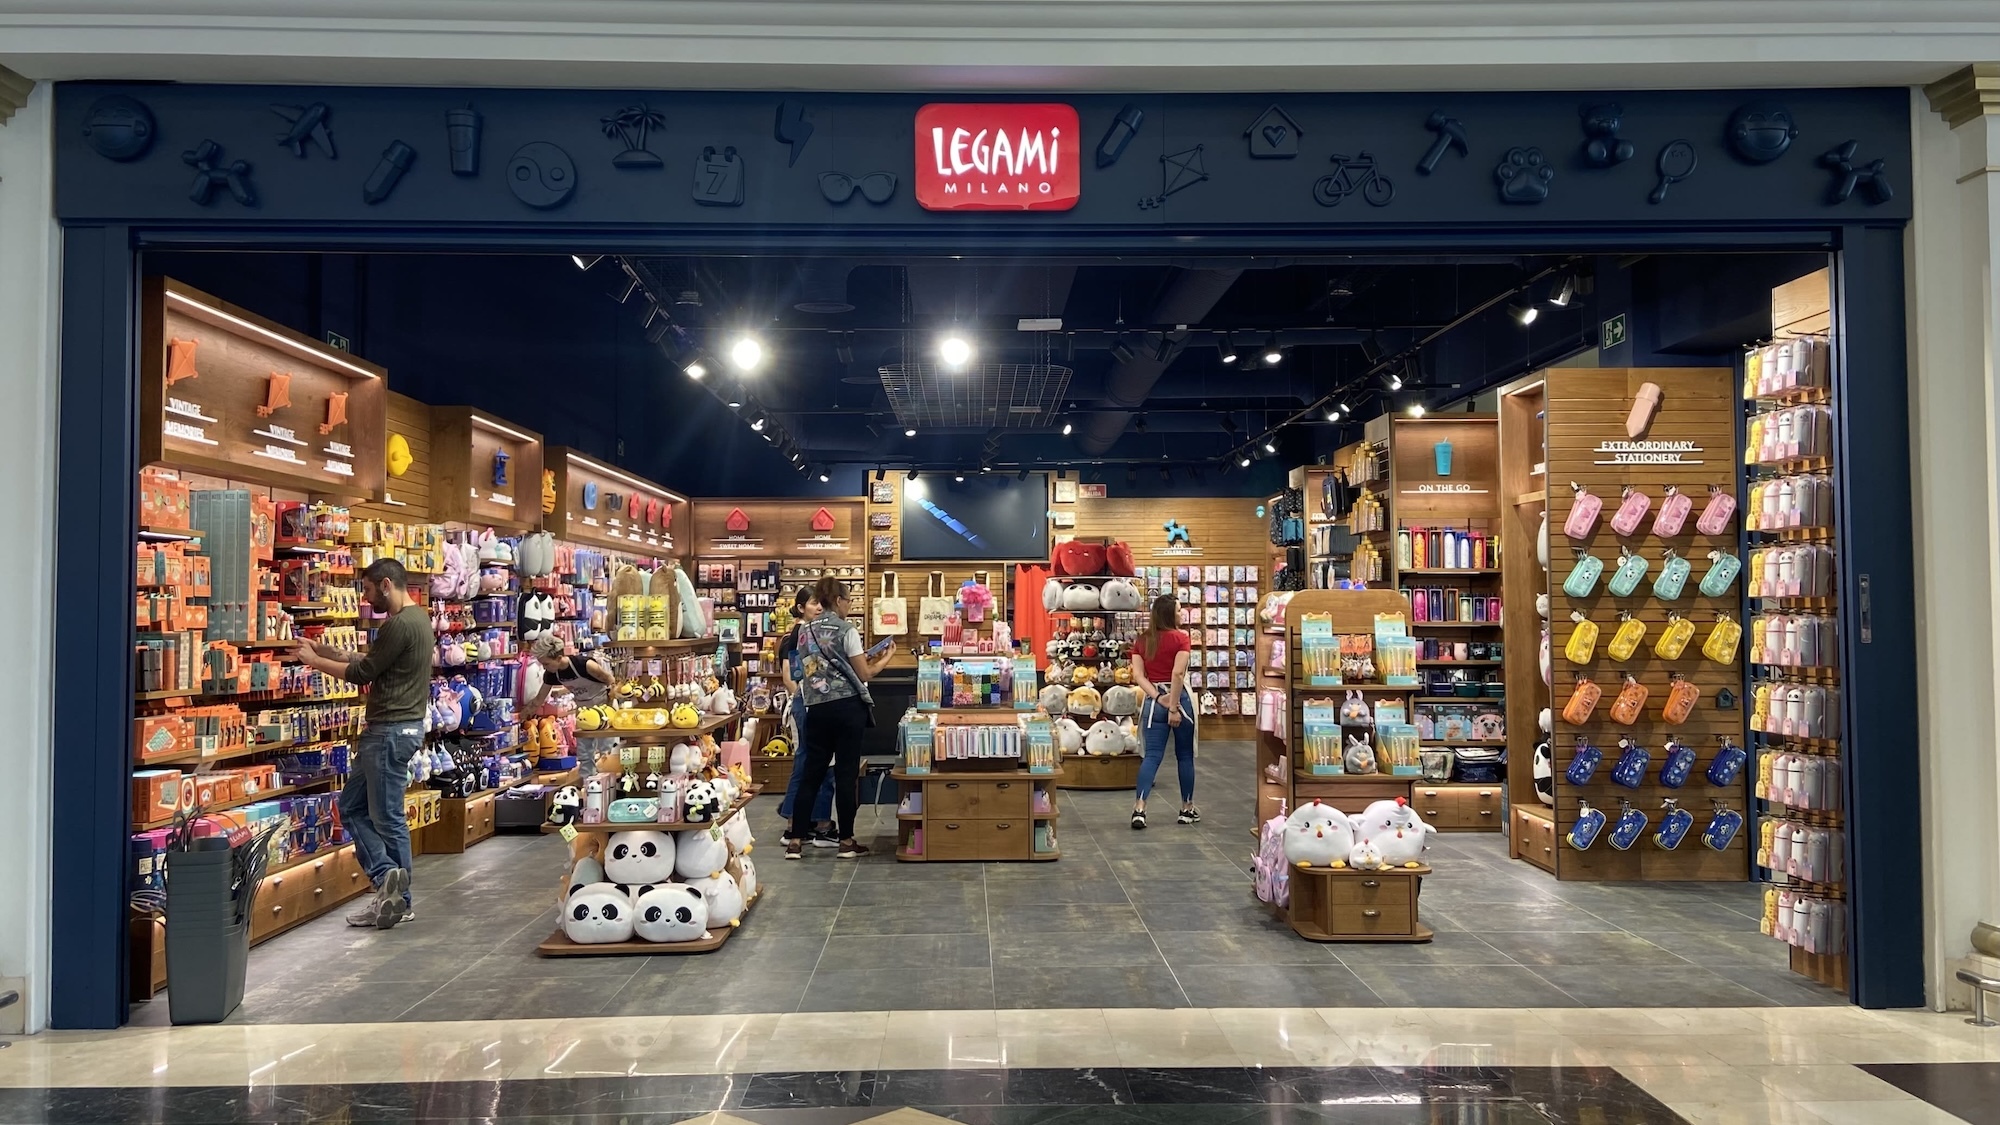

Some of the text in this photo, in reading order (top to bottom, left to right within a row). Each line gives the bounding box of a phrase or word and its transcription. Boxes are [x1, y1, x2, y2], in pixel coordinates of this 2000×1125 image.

[944, 182, 1051, 194] MILANO
[168, 397, 202, 416] VINTAGE
[164, 420, 205, 439] MEMORIES
[269, 424, 295, 440] VINTAGE
[1601, 440, 1695, 450] EXTRAORDINARY
[1614, 453, 1682, 462] STATIONERY
[1418, 484, 1471, 492] ON THE GO
